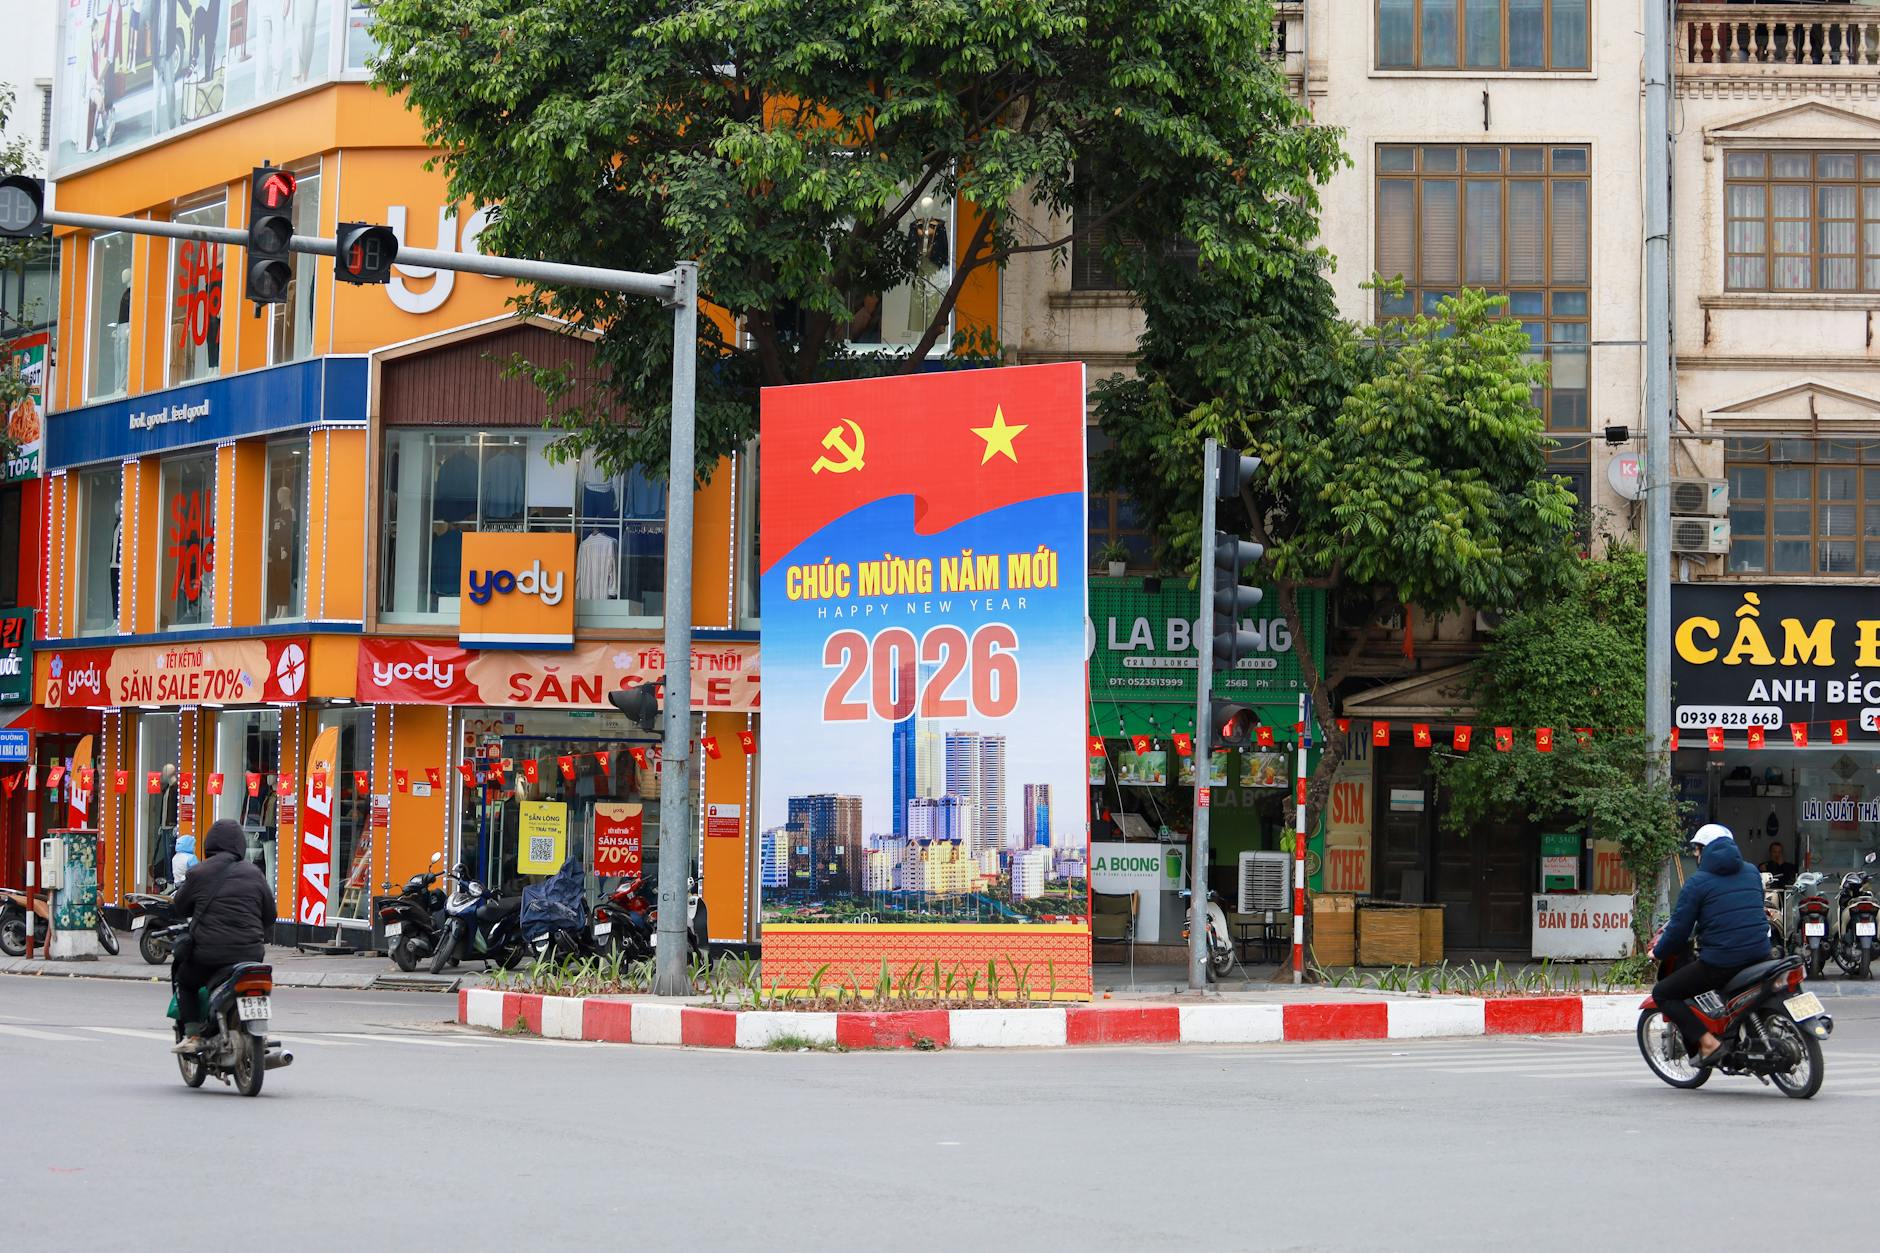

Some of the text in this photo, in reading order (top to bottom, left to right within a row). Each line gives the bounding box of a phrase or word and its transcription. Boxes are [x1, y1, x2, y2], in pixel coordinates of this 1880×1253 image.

[179, 240, 222, 289] SAL
[8, 458, 29, 477] TOP
[30, 456, 38, 473] 4
[170, 488, 214, 543] SAL
[469, 560, 563, 606] yody
[786, 544, 1059, 600] CHÚC MỪNG NĂM MỚI
[818, 597, 1028, 619] HAPPY NEW YEAR
[0, 617, 23, 649] 킨
[1108, 617, 1292, 652] LA BNG
[1674, 591, 1836, 666] CẦM
[68, 662, 100, 695] yody
[120, 668, 152, 702] SĂN
[156, 673, 200, 700] SALE
[203, 668, 243, 699] 70%
[373, 656, 454, 688] yody
[508, 666, 603, 703] SĂN
[822, 622, 1020, 724] 2026
[1128, 678, 1183, 686] 0523513999
[1747, 679, 1816, 703] ANH
[1680, 711, 1875, 726] 0939 828 668 2
[1332, 782, 1365, 825] SIM
[1803, 795, 1880, 821] LÃI SUẤT THẤ
[598, 835, 639, 846] SĂN SALE
[598, 847, 638, 864] 70%
[1111, 857, 1159, 871] BOONG
[1329, 836, 1366, 891] THẺ
[1539, 908, 1628, 932] BÁN ĐÁ SẠCH
